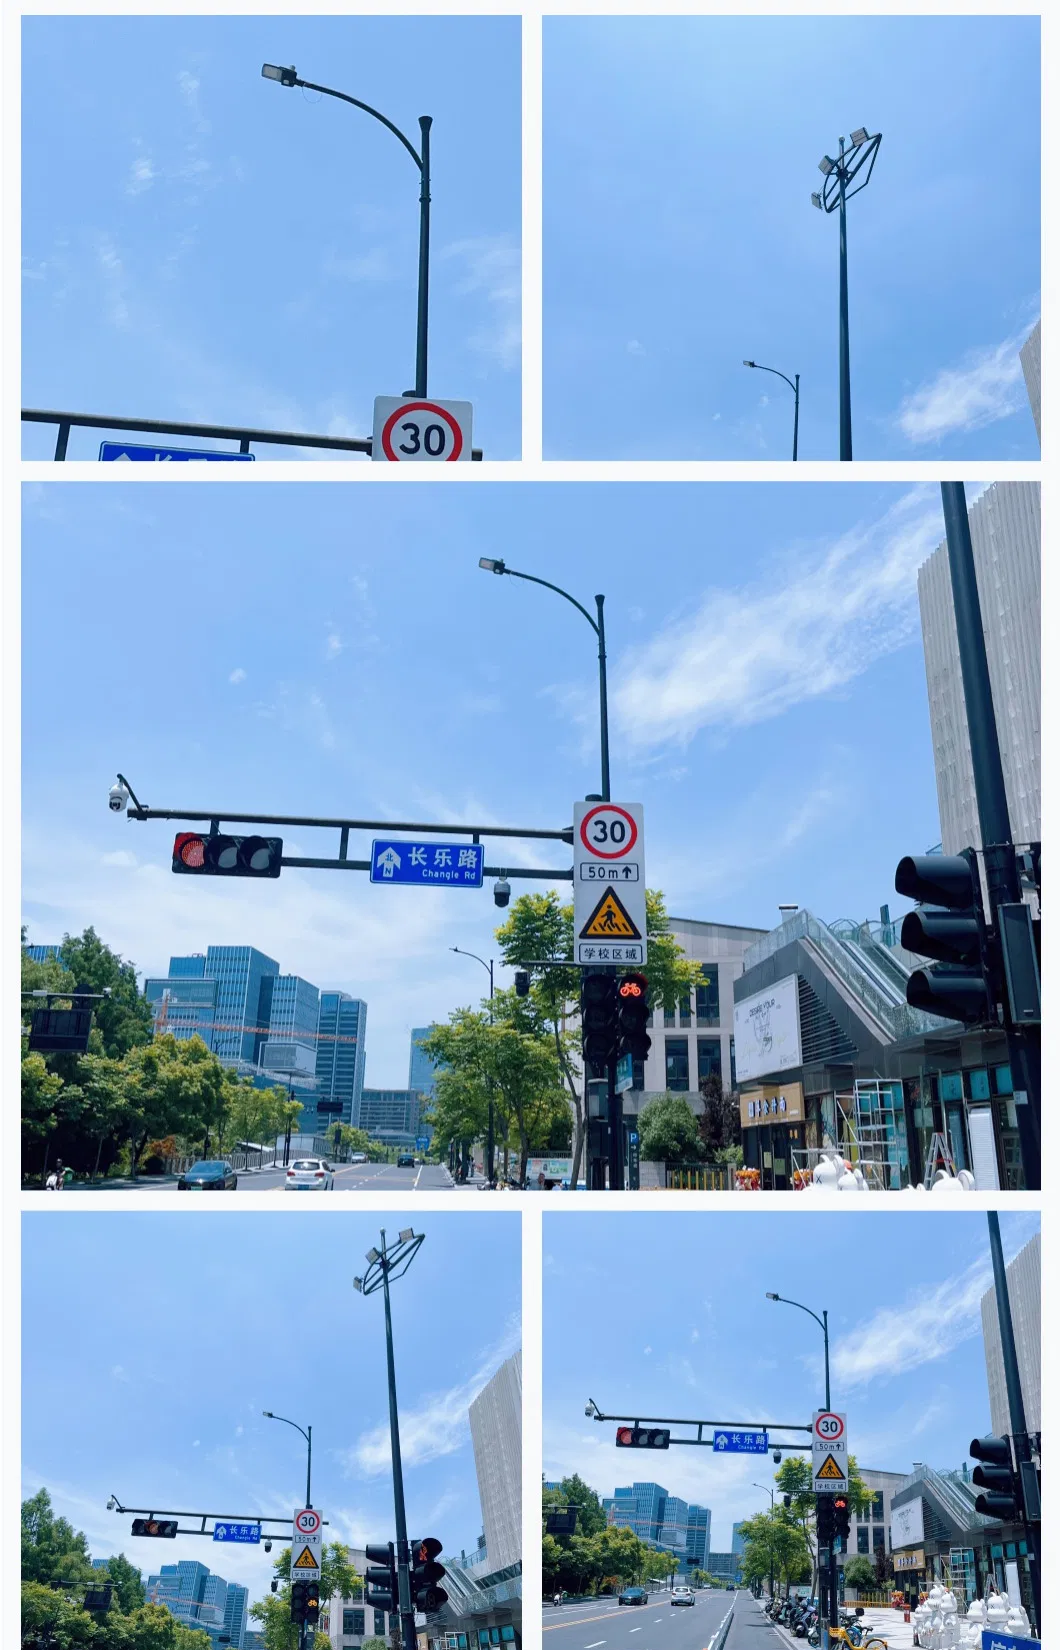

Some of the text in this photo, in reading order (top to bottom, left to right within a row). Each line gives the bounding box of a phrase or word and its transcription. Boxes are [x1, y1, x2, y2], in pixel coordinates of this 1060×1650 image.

[399, 422, 445, 456] 30
[593, 820, 625, 843] 30
[385, 853, 393, 862] 北
[408, 847, 477, 868] 长乐路
[422, 869, 476, 880] Changle Rd
[588, 866, 618, 879] 50m
[584, 948, 637, 960] 学校区域
[630, 1133, 637, 1142] P
[822, 1421, 838, 1433] 30
[731, 1434, 765, 1445] 长乐路
[301, 1517, 315, 1527] 30
[230, 1525, 259, 1535] 长乐路
